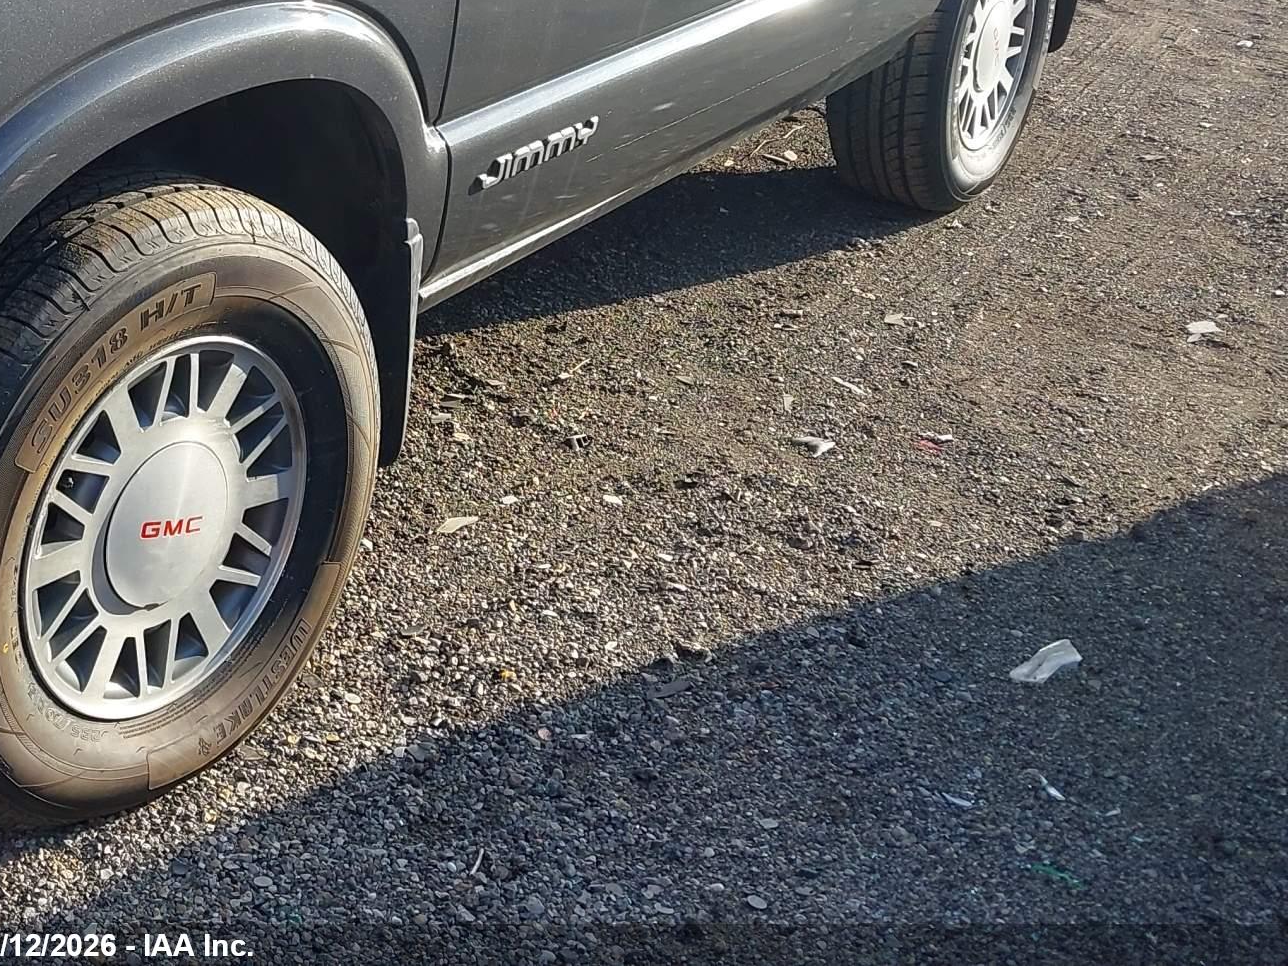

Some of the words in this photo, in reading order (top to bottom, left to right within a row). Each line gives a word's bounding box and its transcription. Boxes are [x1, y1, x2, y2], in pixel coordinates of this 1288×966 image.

[31, 326, 129, 455] SU318
[139, 283, 202, 332] H/T
[140, 515, 203, 539] GMC
[213, 617, 314, 745] WESTLAKE
